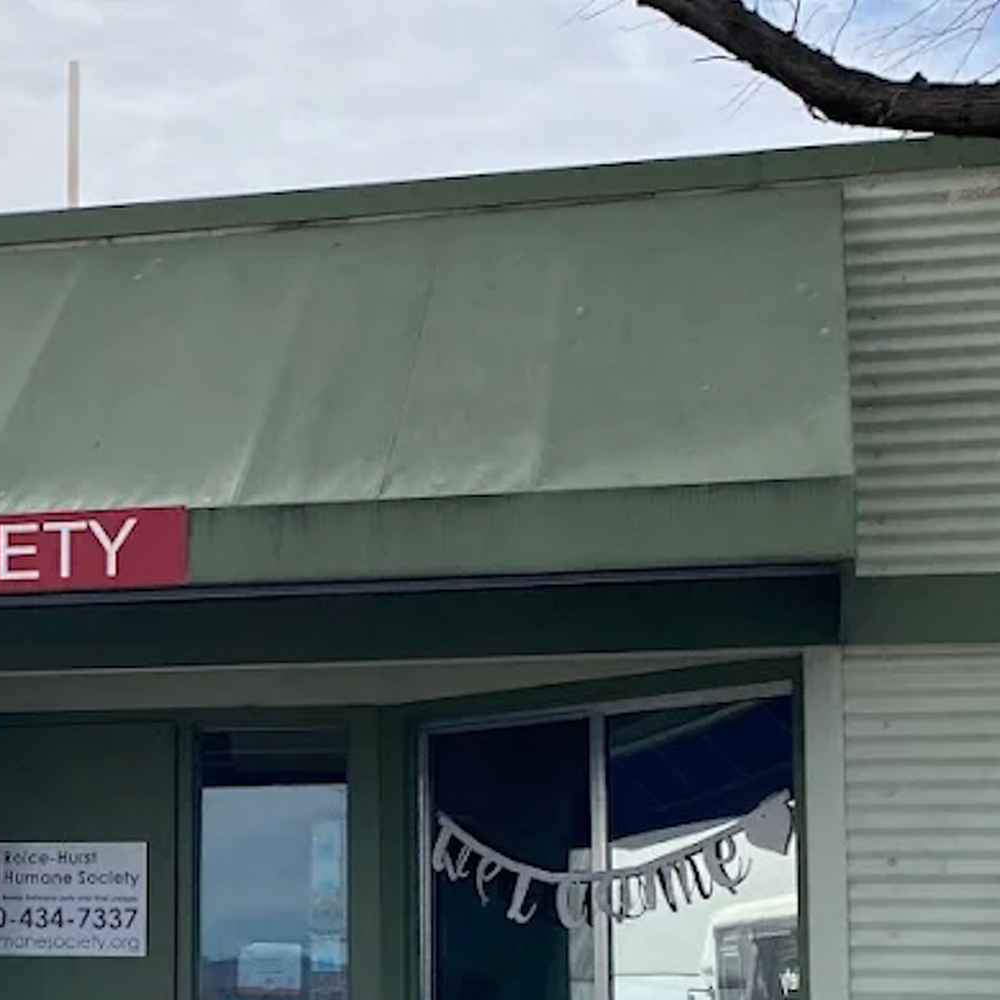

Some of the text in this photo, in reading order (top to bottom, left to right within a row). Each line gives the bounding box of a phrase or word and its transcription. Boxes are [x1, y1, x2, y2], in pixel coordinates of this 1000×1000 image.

[4, 850, 97, 864] Roice-Hurst
[4, 870, 140, 887] Humane Society
